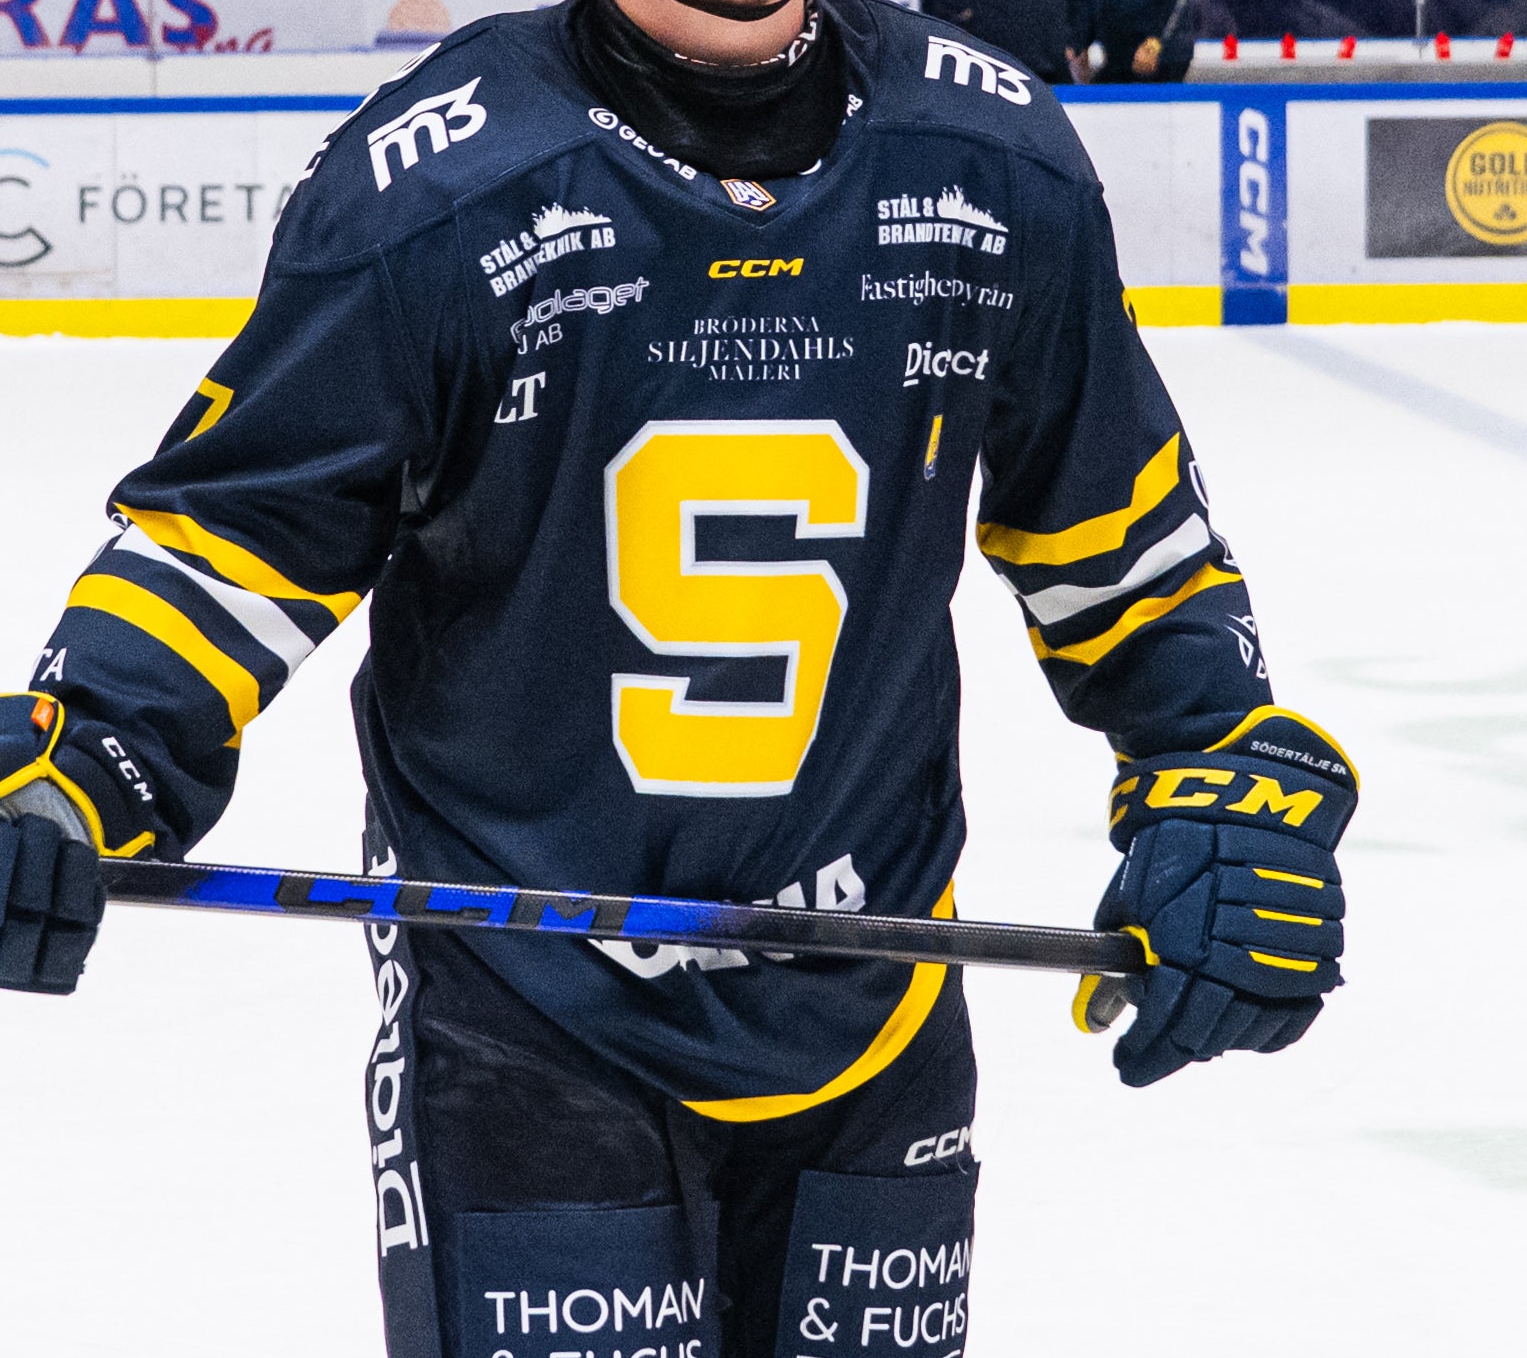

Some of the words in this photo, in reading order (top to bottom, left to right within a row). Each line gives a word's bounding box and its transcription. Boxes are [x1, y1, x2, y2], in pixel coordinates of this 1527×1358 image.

[877, 193, 921, 220] STÅL
[922, 196, 935, 218] &
[1238, 107, 1271, 276] CCM
[479, 239, 524, 275] STÅL
[519, 230, 538, 251] &
[590, 227, 616, 249] AB
[980, 233, 1007, 256] AB
[708, 256, 806, 279] CCM
[535, 323, 564, 350] AB
[693, 314, 821, 337] BRÖDERNA
[645, 334, 857, 369] SILJENDAHLS
[604, 419, 871, 796] S
[100, 736, 154, 803] CCM
[1250, 740, 1330, 771] SÖDERTÄLJE
[1109, 767, 1325, 828] CCM
[484, 1277, 705, 1336] THOMAN
[798, 1296, 840, 1344] &
[859, 1293, 967, 1348] FUCHS
